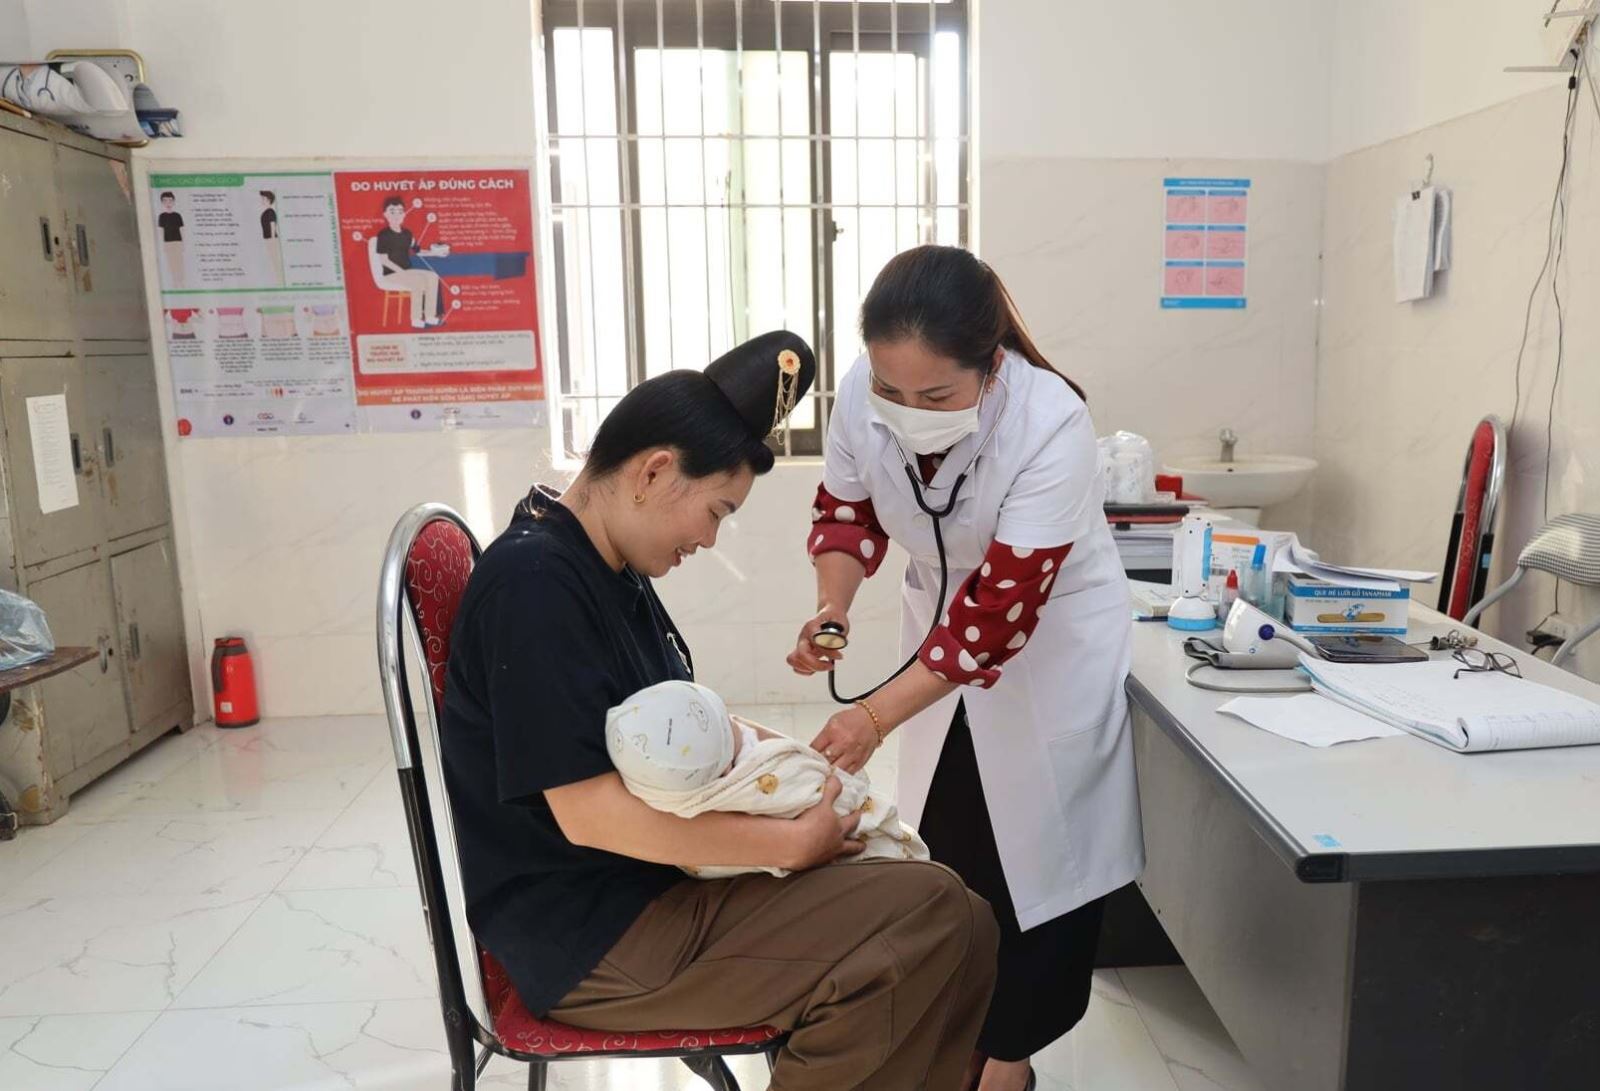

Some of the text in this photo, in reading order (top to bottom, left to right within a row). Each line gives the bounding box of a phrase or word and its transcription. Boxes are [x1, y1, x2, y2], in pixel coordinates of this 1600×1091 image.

[351, 181, 371, 192] ĐO
[418, 177, 436, 190] ÁP
[439, 177, 476, 190] ĐÚNG
[479, 177, 515, 190] CÁCH
